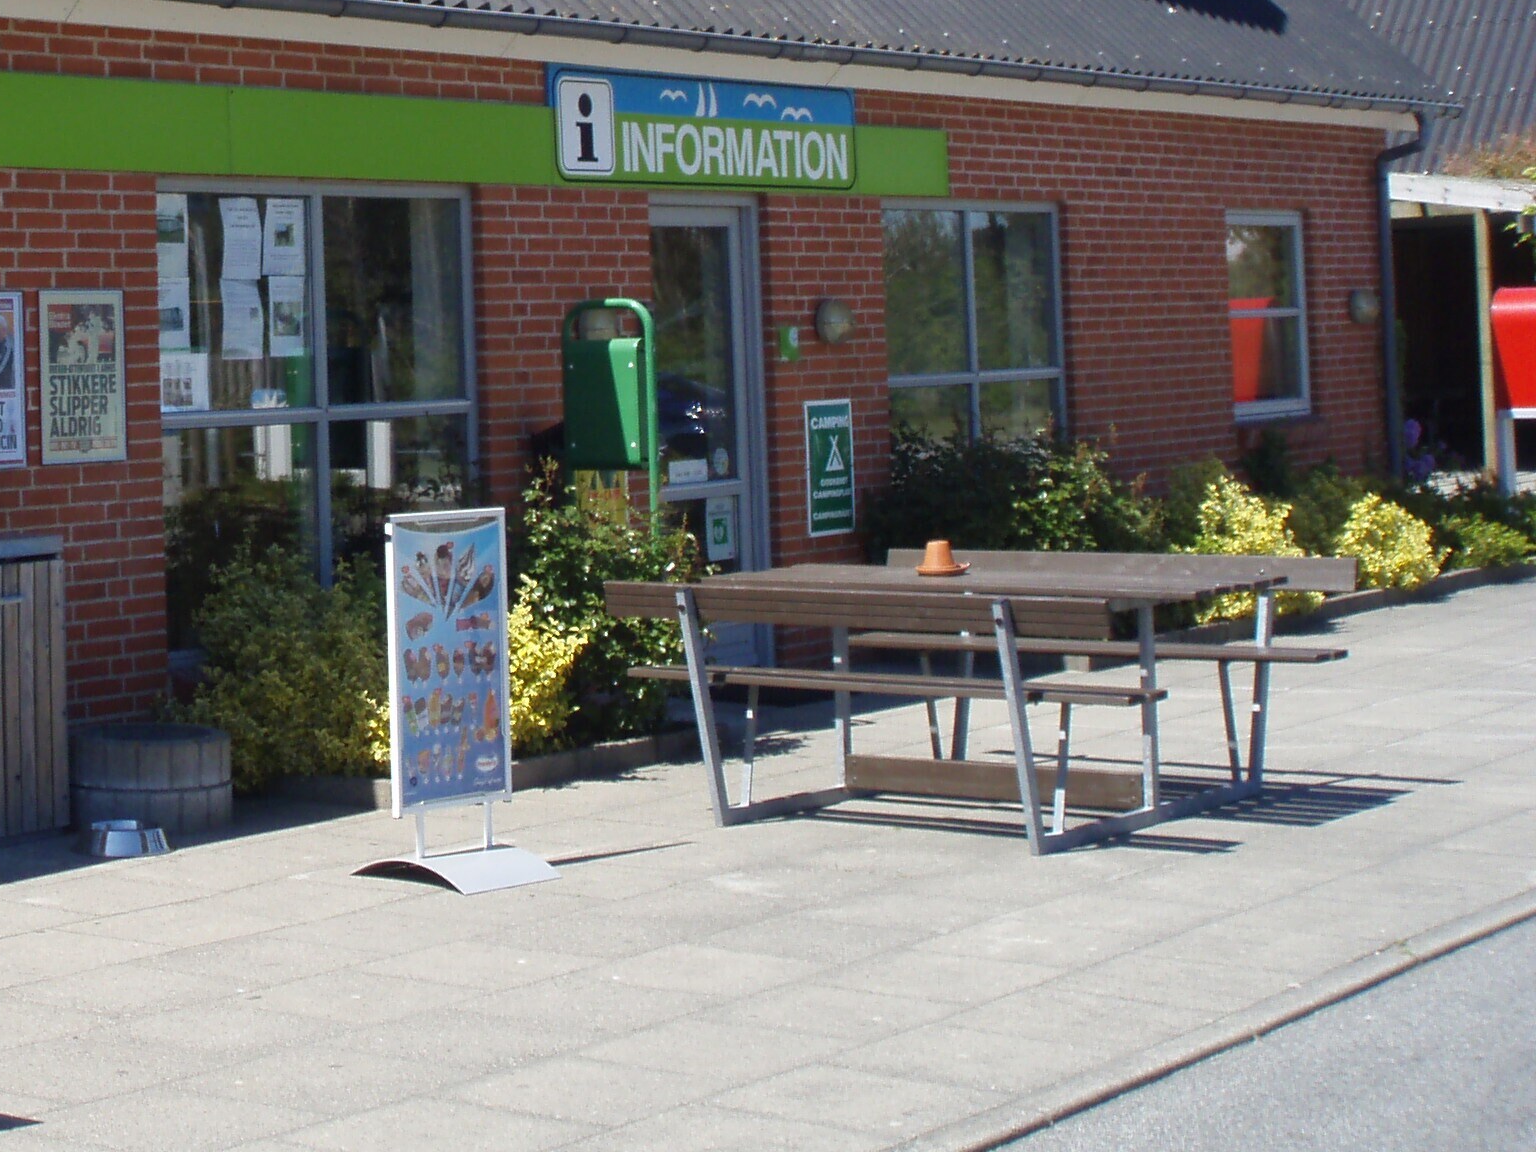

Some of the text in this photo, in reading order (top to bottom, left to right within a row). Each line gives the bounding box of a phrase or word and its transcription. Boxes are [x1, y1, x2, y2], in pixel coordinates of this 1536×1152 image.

[622, 120, 849, 180] INFORMATION
[49, 374, 117, 396] STIKKERE
[49, 395, 108, 416] SLIPPER
[50, 416, 102, 438] ALDRIG
